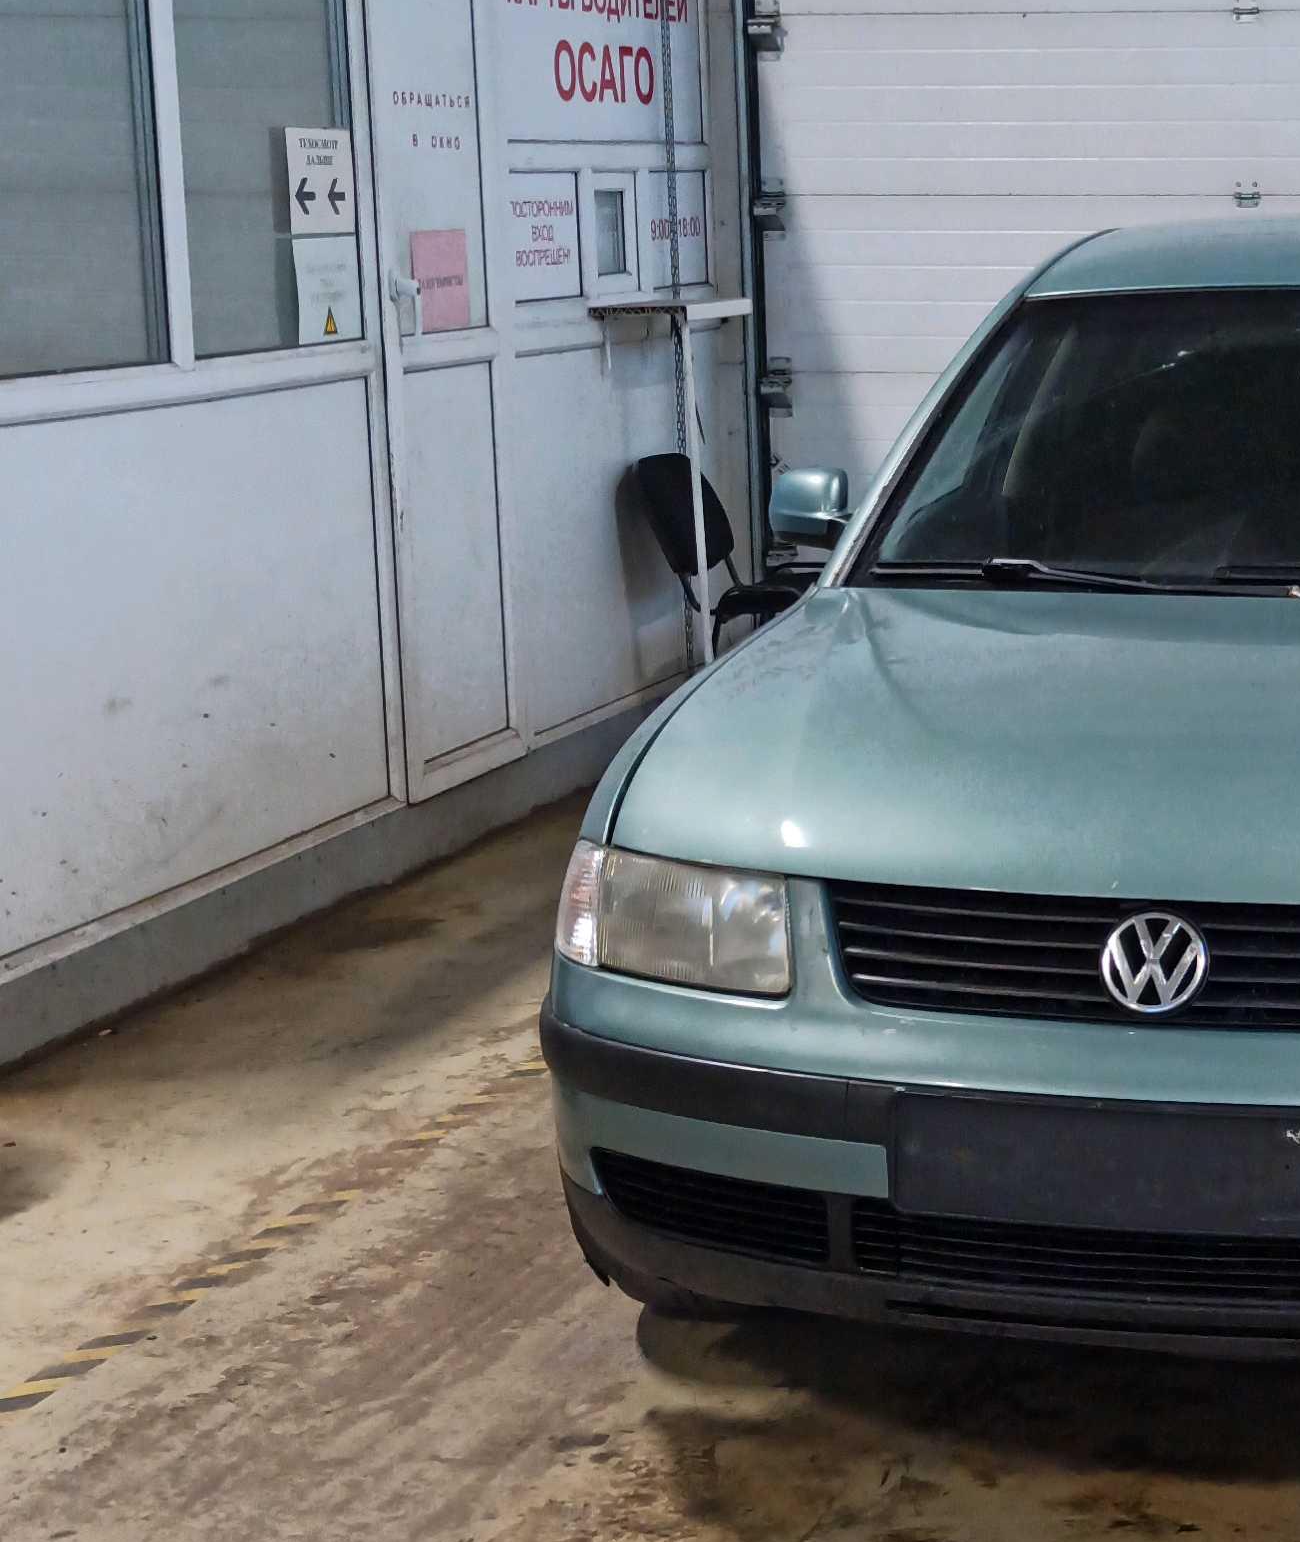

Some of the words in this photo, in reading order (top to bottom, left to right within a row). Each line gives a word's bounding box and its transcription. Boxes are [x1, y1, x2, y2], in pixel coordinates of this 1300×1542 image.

[554, 39, 654, 105] ОСАГО
[392, 90, 471, 109] ОБРАЩАТЬСЯ
[412, 133, 418, 147] В
[431, 135, 461, 150] ОКНО
[531, 224, 554, 242] ВХОД
